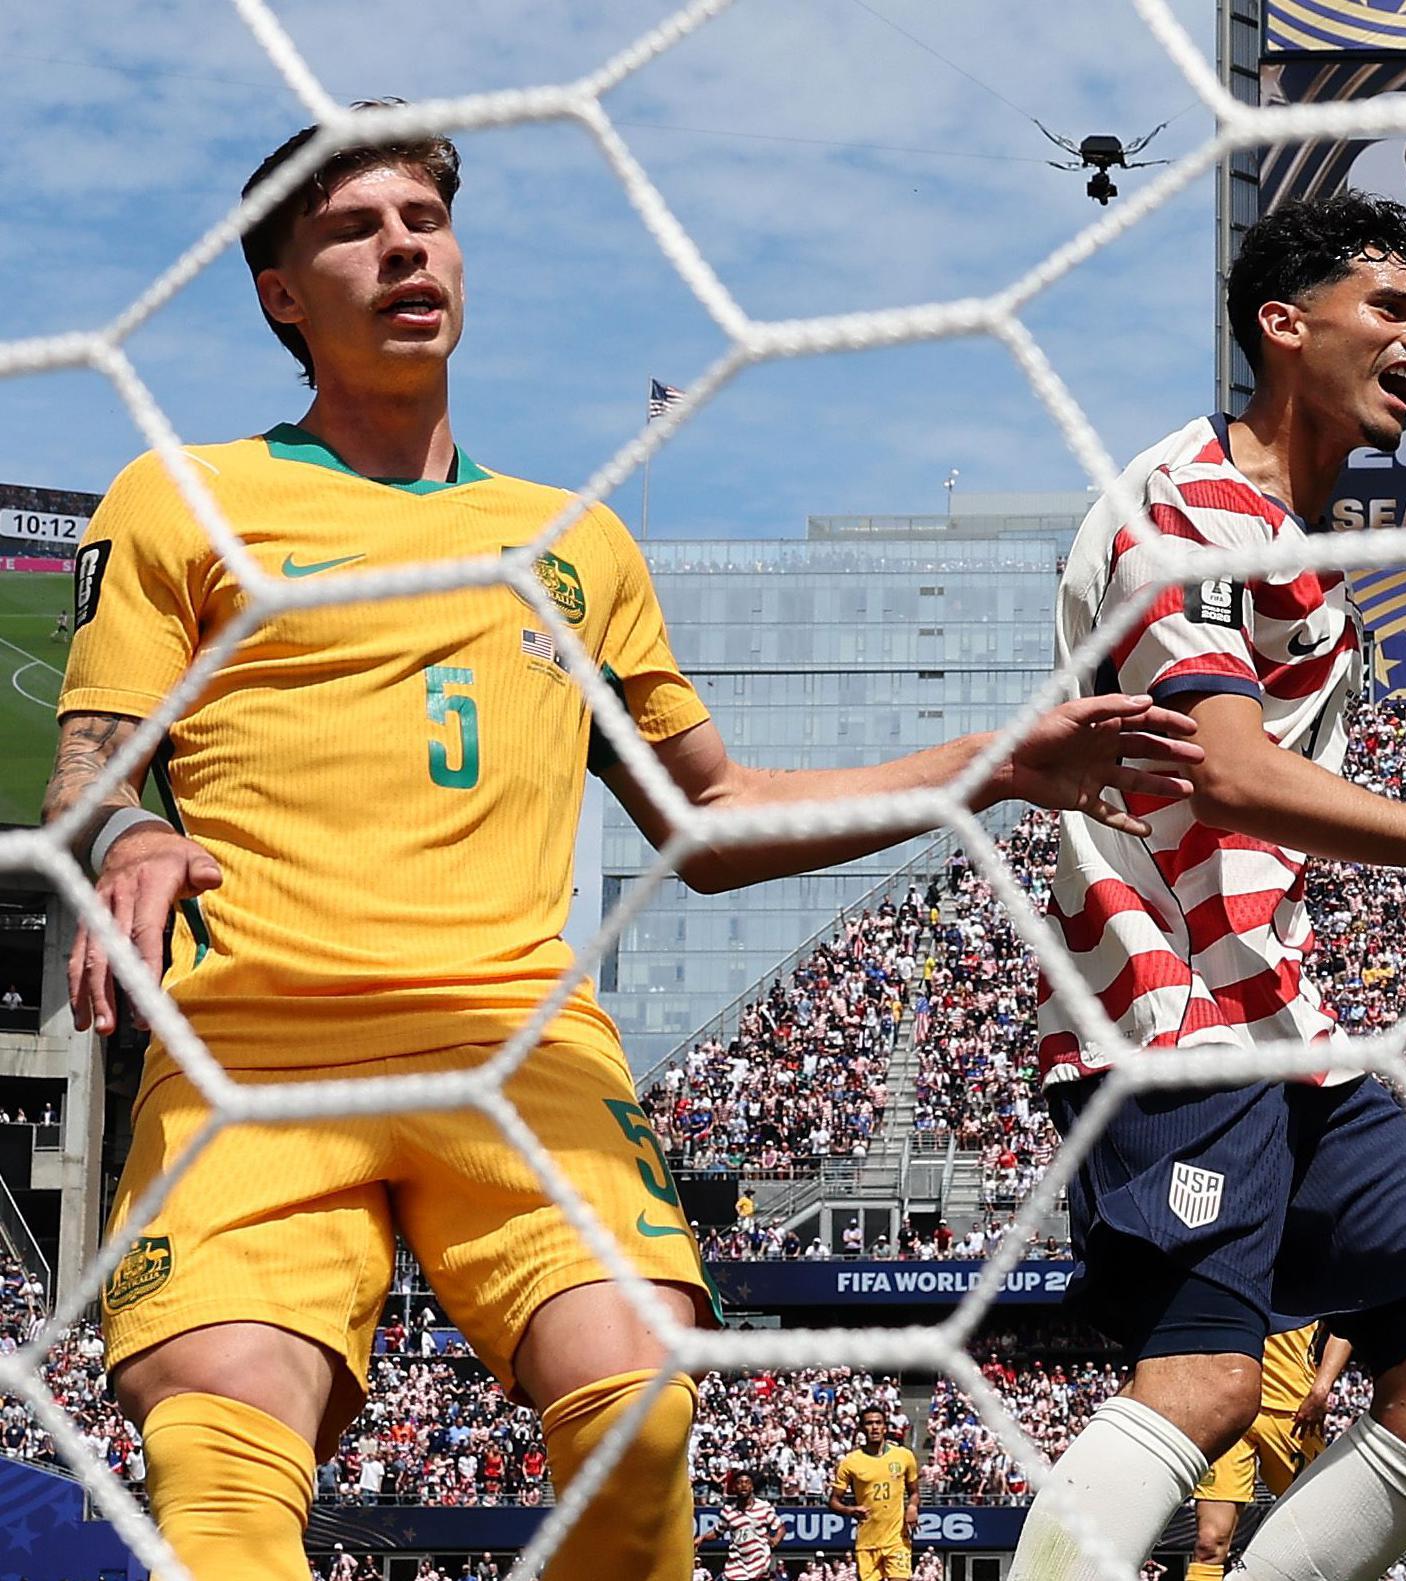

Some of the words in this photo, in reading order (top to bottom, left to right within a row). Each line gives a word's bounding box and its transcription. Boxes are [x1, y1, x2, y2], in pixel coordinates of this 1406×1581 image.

[13, 513, 77, 539] 10:12
[425, 665, 479, 790] 5
[602, 1098, 680, 1208] 5
[1177, 1166, 1220, 1194] USA
[837, 1272, 892, 1293] FIFA
[894, 1272, 988, 1293] WORLD
[873, 1482, 890, 1501] 23
[851, 1513, 975, 1541] 26
